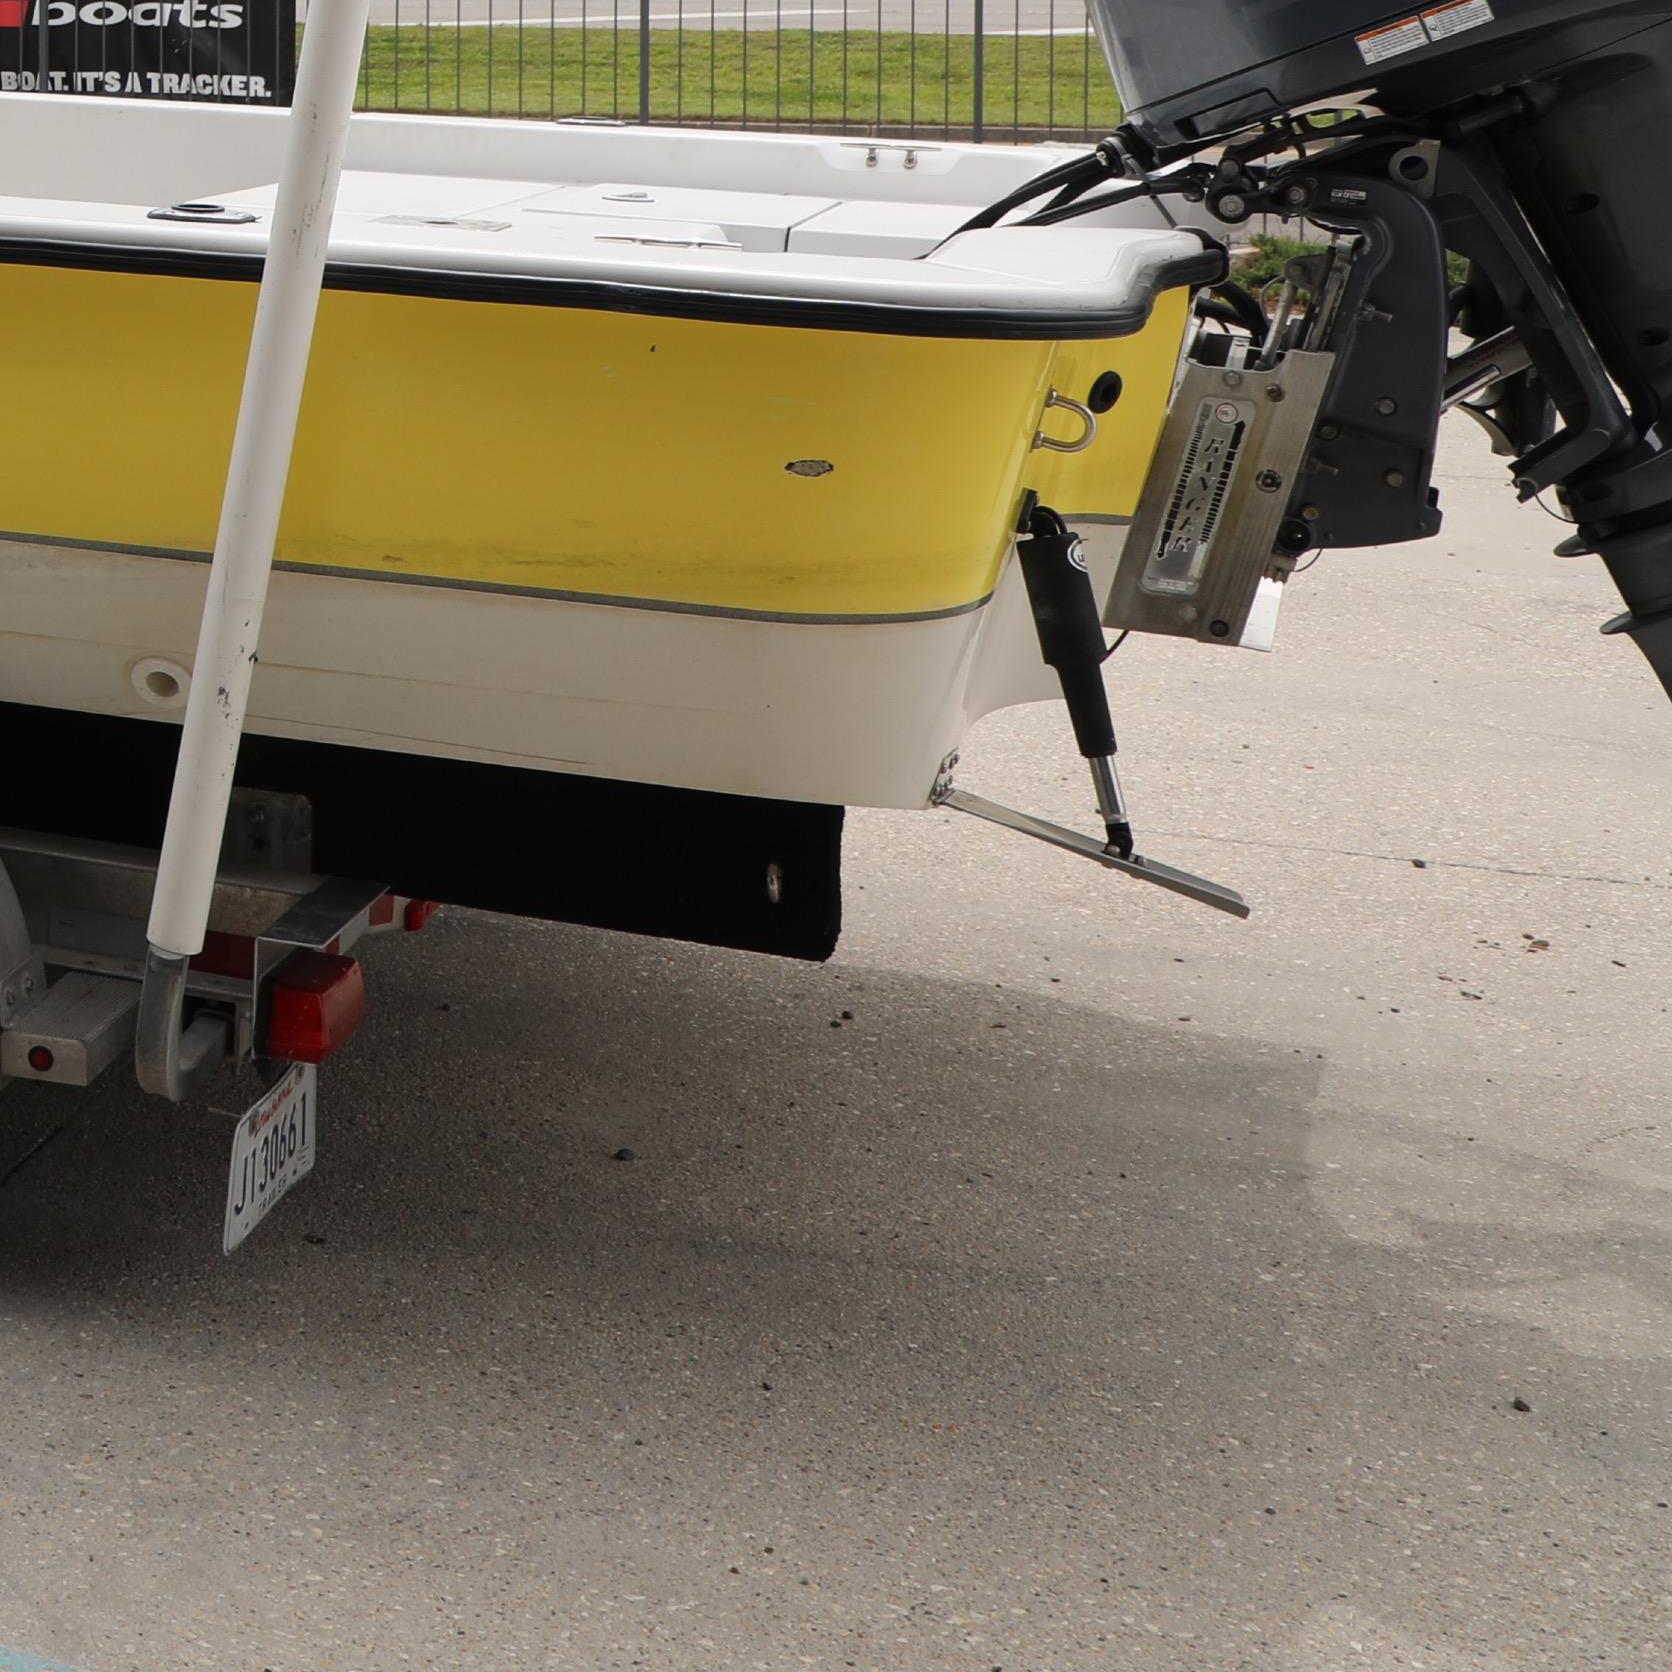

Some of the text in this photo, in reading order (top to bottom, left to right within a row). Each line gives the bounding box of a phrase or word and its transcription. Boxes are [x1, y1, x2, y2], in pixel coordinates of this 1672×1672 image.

[1, 71, 68, 92] BOAT.
[72, 71, 121, 93] IT'S
[125, 71, 143, 94] A
[146, 72, 272, 97] TRACKER.
[234, 1090, 307, 1216] J130661
